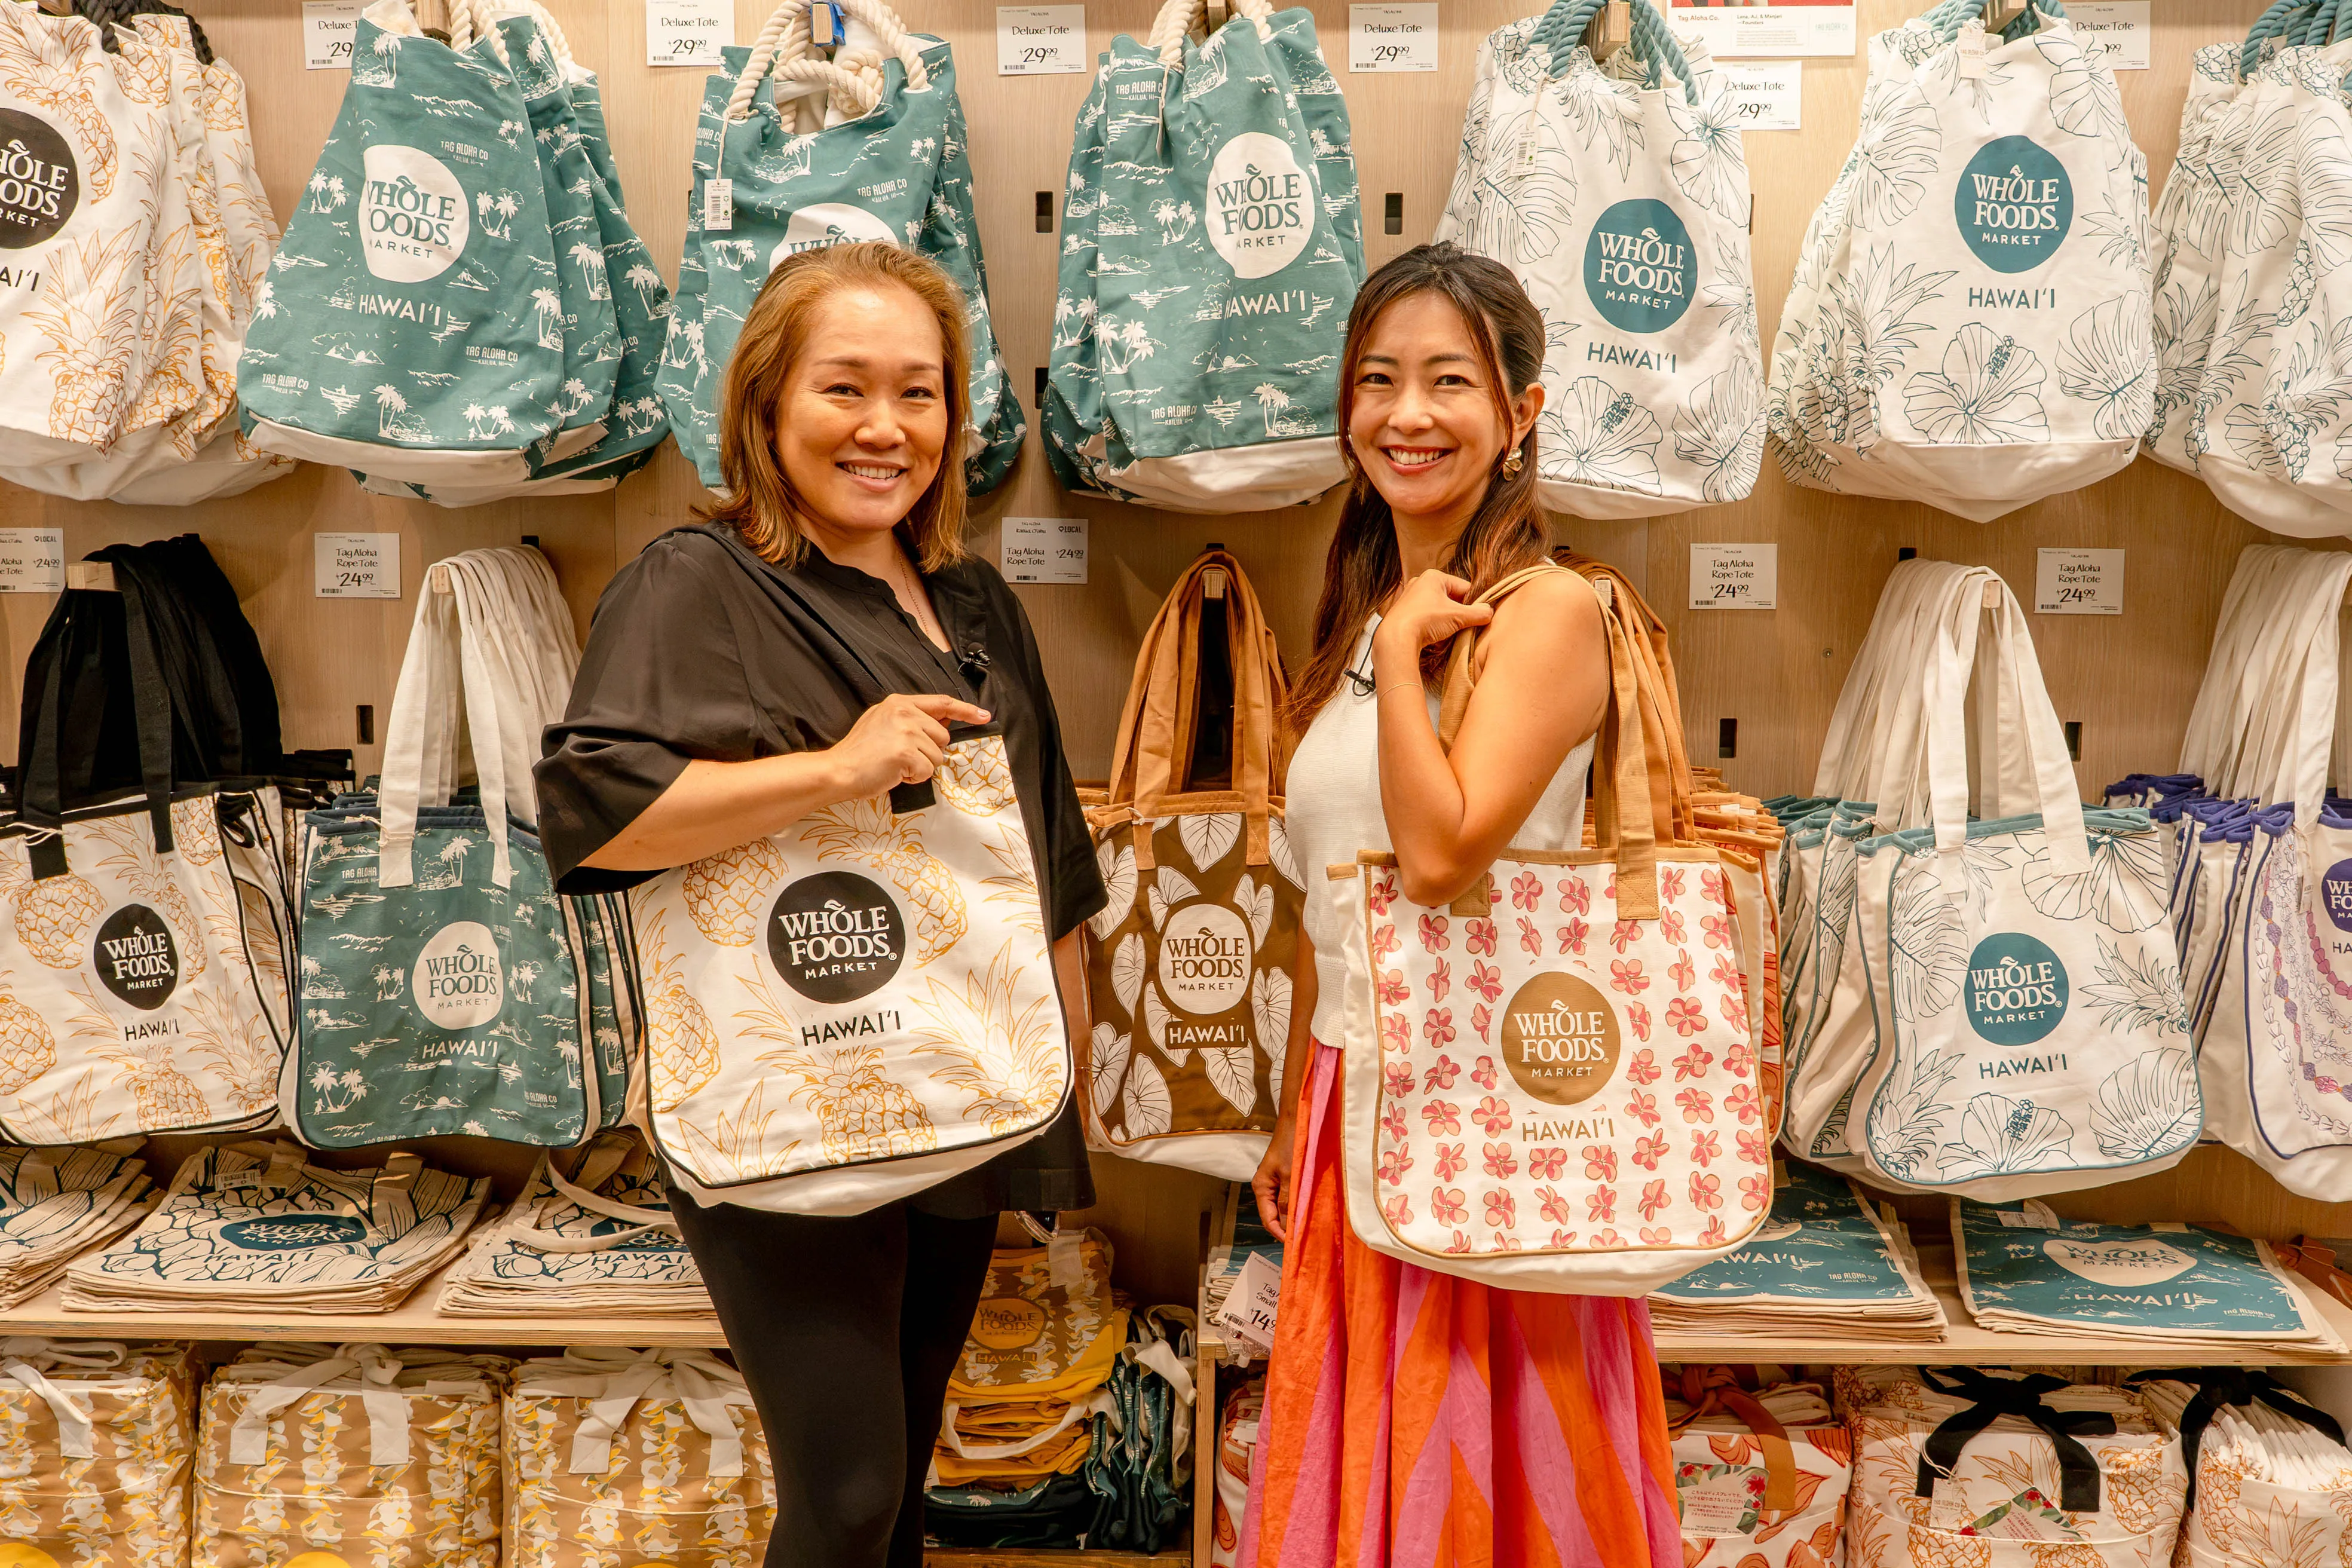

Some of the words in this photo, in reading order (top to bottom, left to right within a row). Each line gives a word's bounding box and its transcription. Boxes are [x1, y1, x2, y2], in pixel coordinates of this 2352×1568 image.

[318, 20, 351, 30] Deluxe
[661, 17, 694, 27] Deluxe
[696, 17, 719, 27] Tote
[1364, 24, 1398, 33] Deluxe
[1399, 23, 1422, 33] Tote
[2076, 22, 2110, 31] Deluxe
[2110, 21, 2134, 30] Tote
[1012, 26, 1046, 35] Deluxe
[1046, 25, 1070, 35] Tote
[1115, 84, 1130, 95] TAG
[1131, 81, 1156, 94] ALOHA
[1157, 82, 1162, 93] C
[1763, 81, 1785, 90] Tote
[1278, 118, 1288, 130] TA
[440, 140, 455, 152] TAG
[455, 142, 477, 158] ALOHA
[479, 149, 489, 160] CO
[0, 149, 69, 191] OLE
[857, 186, 872, 197] TAG
[873, 180, 896, 195] ALOHA
[896, 178, 908, 189] CO
[1971, 173, 2060, 204] WHOLE
[1973, 201, 2057, 231] FOODS
[369, 209, 449, 248] OODS
[1981, 233, 2042, 246] MARKET
[373, 240, 433, 259] ARKET
[1598, 232, 1685, 269] WHOLE
[1598, 259, 1683, 297] FOODS
[1605, 290, 1671, 311] MARKET
[567, 314, 578, 324] CO
[629, 336, 639, 346] CO
[466, 346, 480, 357] TAG
[482, 347, 506, 360] ALOHA
[508, 351, 518, 362] CO
[262, 373, 275, 384] TAG
[277, 375, 298, 387] ALOHA
[297, 378, 310, 390] CO
[1150, 407, 1165, 419] TAG
[1167, 405, 1191, 417] ALOHA
[706, 433, 716, 444] TAG
[336, 548, 353, 559] Tag
[353, 549, 377, 557] Aloha
[1006, 547, 1022, 557] Tag
[336, 559, 359, 568] Rope
[1007, 557, 1027, 566] Rope
[1711, 559, 1728, 569] Tag
[1712, 570, 1734, 580] Rope
[1734, 570, 1754, 578] Tote
[2058, 564, 2075, 574] Tag
[2058, 574, 2080, 584] Rope
[2081, 575, 2101, 583] Tote
[341, 868, 355, 878] TAG
[357, 866, 377, 877] ALOHA
[779, 905, 890, 939] WHOLE
[102, 932, 168, 959] WHOLE
[789, 935, 890, 966] FOODS
[1166, 937, 1245, 958] WHOLE
[112, 955, 171, 979] FOODS
[425, 958, 497, 978] WHOLE
[804, 961, 878, 979] MARKET
[1171, 959, 1244, 979] FOODS
[1971, 961, 2056, 990] WHOLE
[127, 978, 164, 990] MARKET
[429, 974, 497, 999] FOODS
[1178, 982, 1234, 991] MARKET
[437, 999, 489, 1010] MARKET
[1974, 984, 2057, 1012] FOODS
[1514, 1011, 1606, 1036] WHOLE
[1983, 1010, 2046, 1025] MARKET
[1521, 1037, 1605, 1063] FOODS
[1532, 1067, 1593, 1078] MARKET
[529, 1092, 547, 1103] ALOHA
[549, 1094, 558, 1102] CO
[2083, 1260, 2163, 1268] MARKET
[1263, 1282, 1277, 1297] Tag
[1256, 1292, 1278, 1309] Small
[979, 1310, 1038, 1322] WHOLE
[981, 1319, 1040, 1331] FOODS
